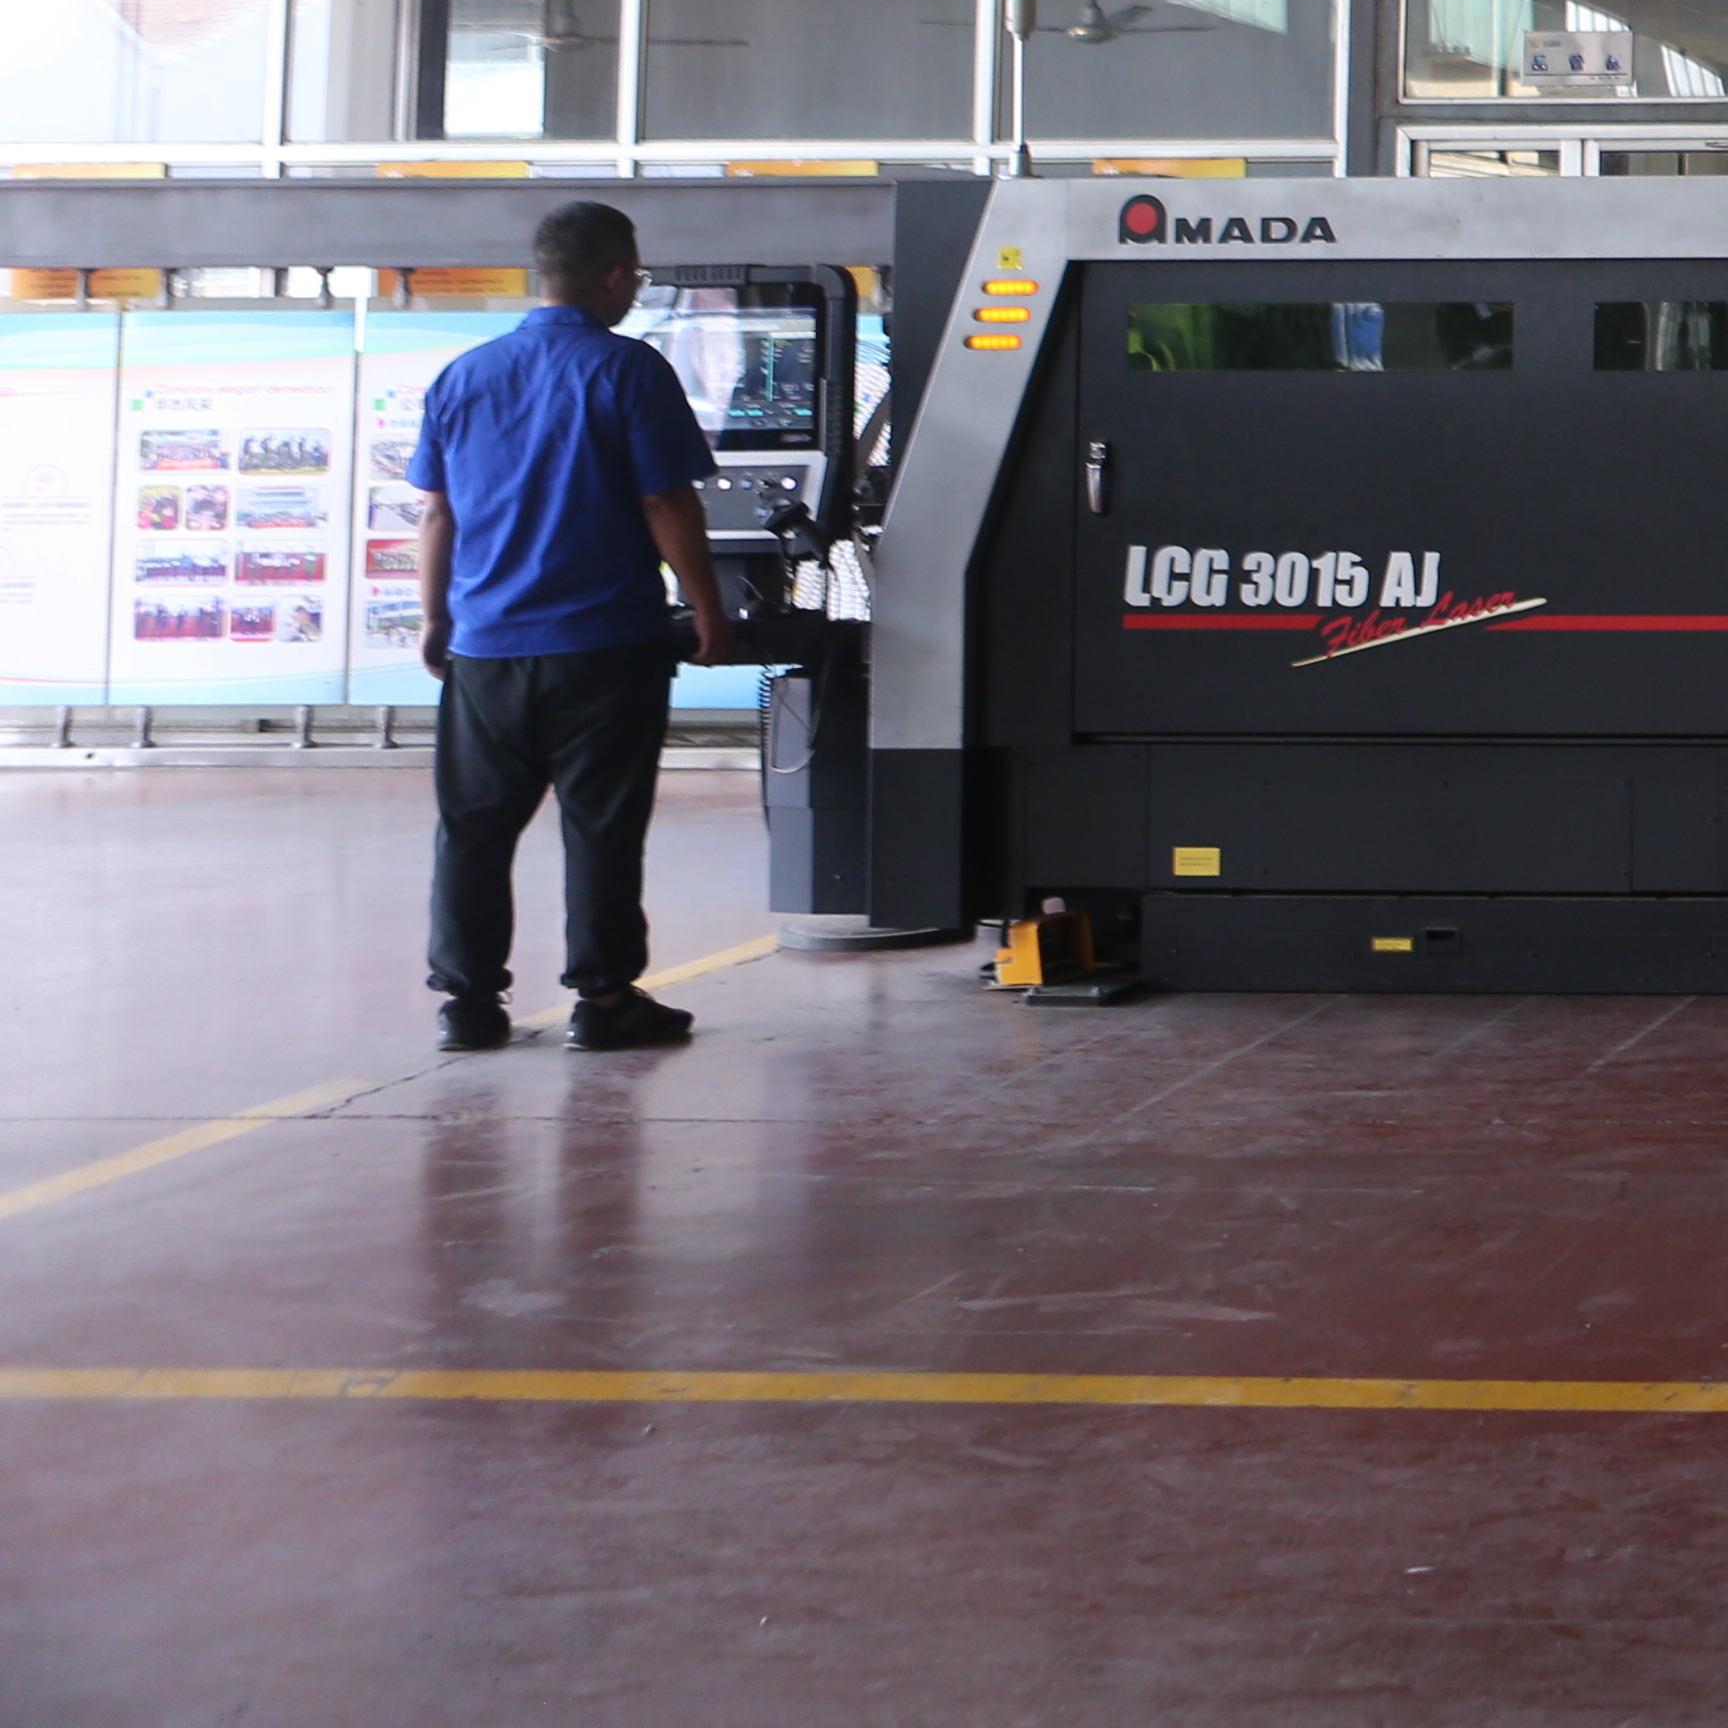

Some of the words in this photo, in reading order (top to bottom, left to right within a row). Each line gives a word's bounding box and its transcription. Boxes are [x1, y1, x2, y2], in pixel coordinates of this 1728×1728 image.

[1119, 194, 1338, 245] AMADA
[1123, 544, 1230, 608] LCG
[1239, 550, 1370, 608] 3015
[1379, 551, 1442, 608] AJ
[1320, 610, 1407, 659] Fiber
[1419, 591, 1518, 630] Laser
